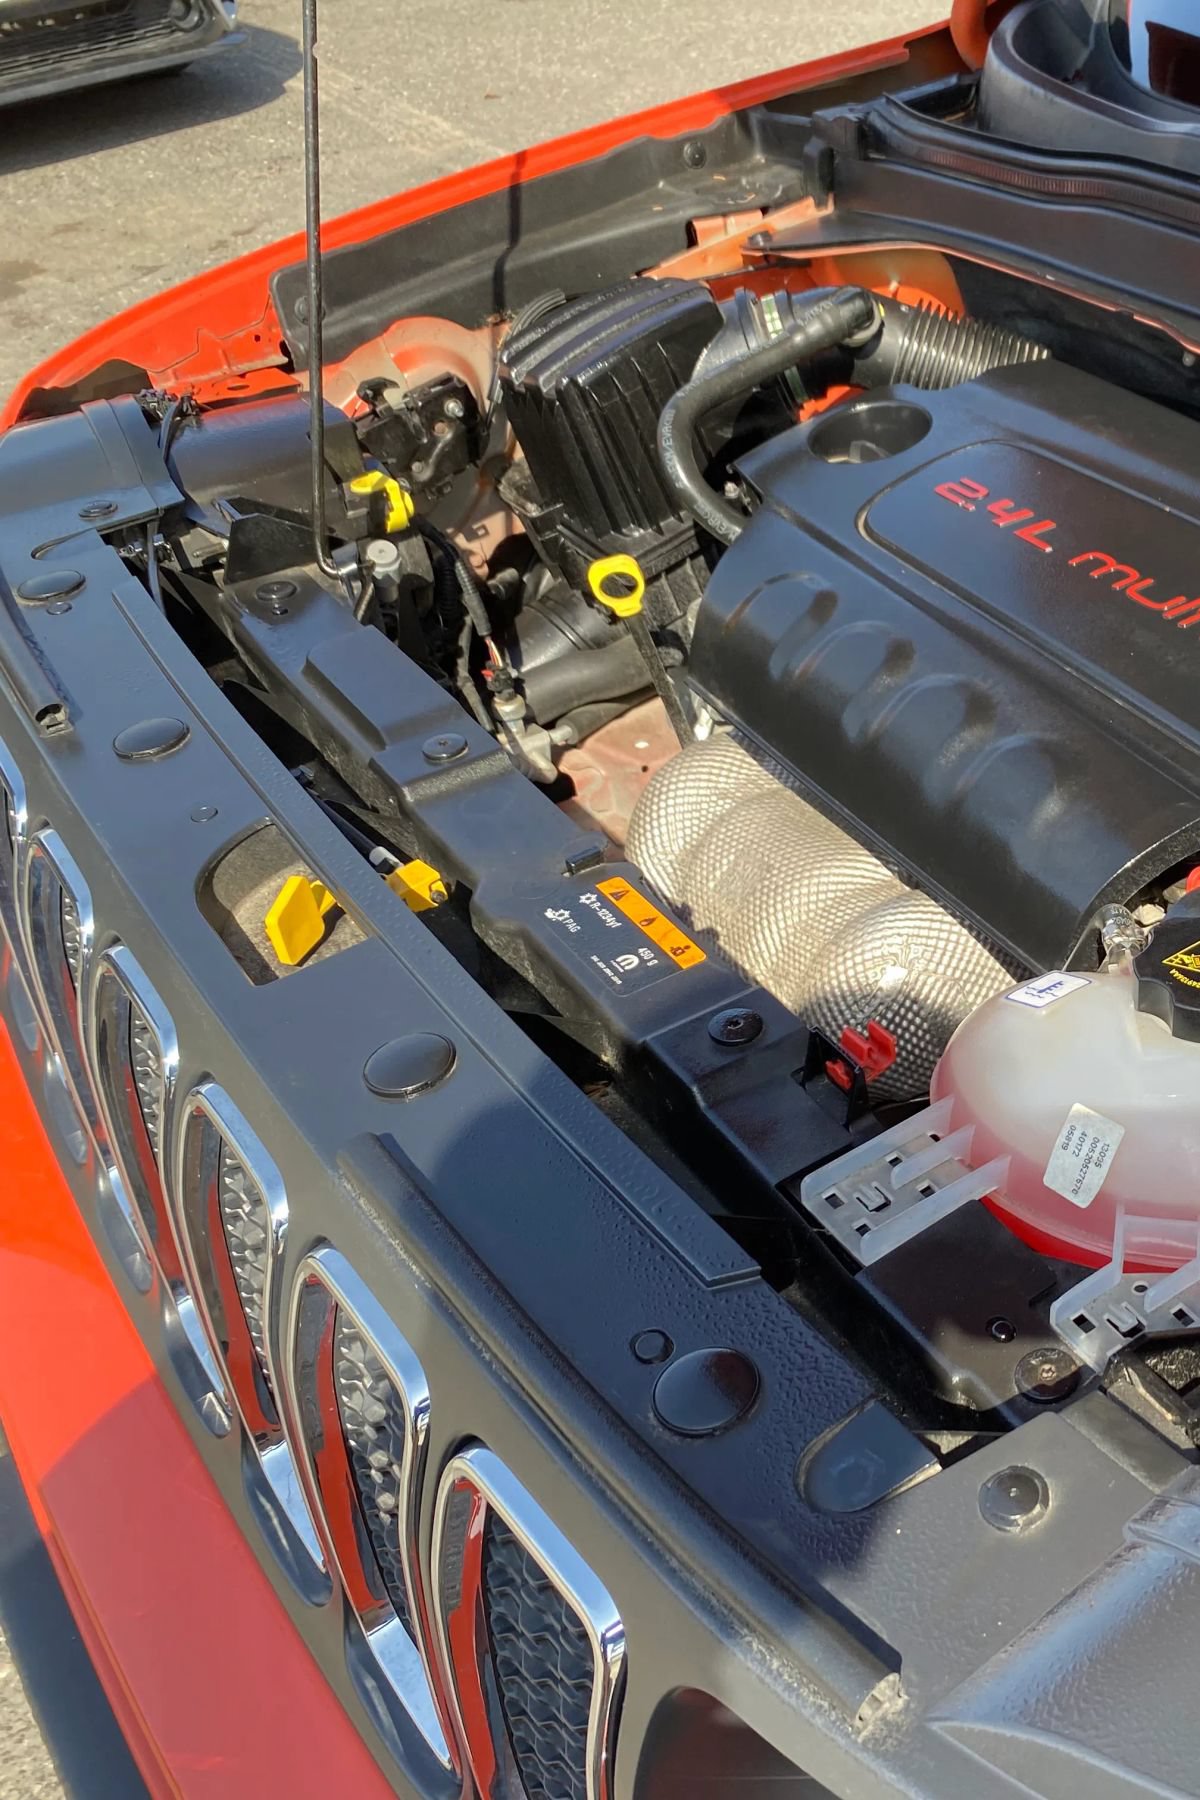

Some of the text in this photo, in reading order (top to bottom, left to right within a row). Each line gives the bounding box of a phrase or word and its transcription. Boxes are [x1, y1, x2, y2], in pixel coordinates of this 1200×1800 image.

[934, 476, 1056, 553] 2.4L
[563, 915, 582, 933] PAG
[638, 947, 655, 960] 450
[1061, 1124, 1077, 1151] 05819
[1072, 1130, 1088, 1158] 40172
